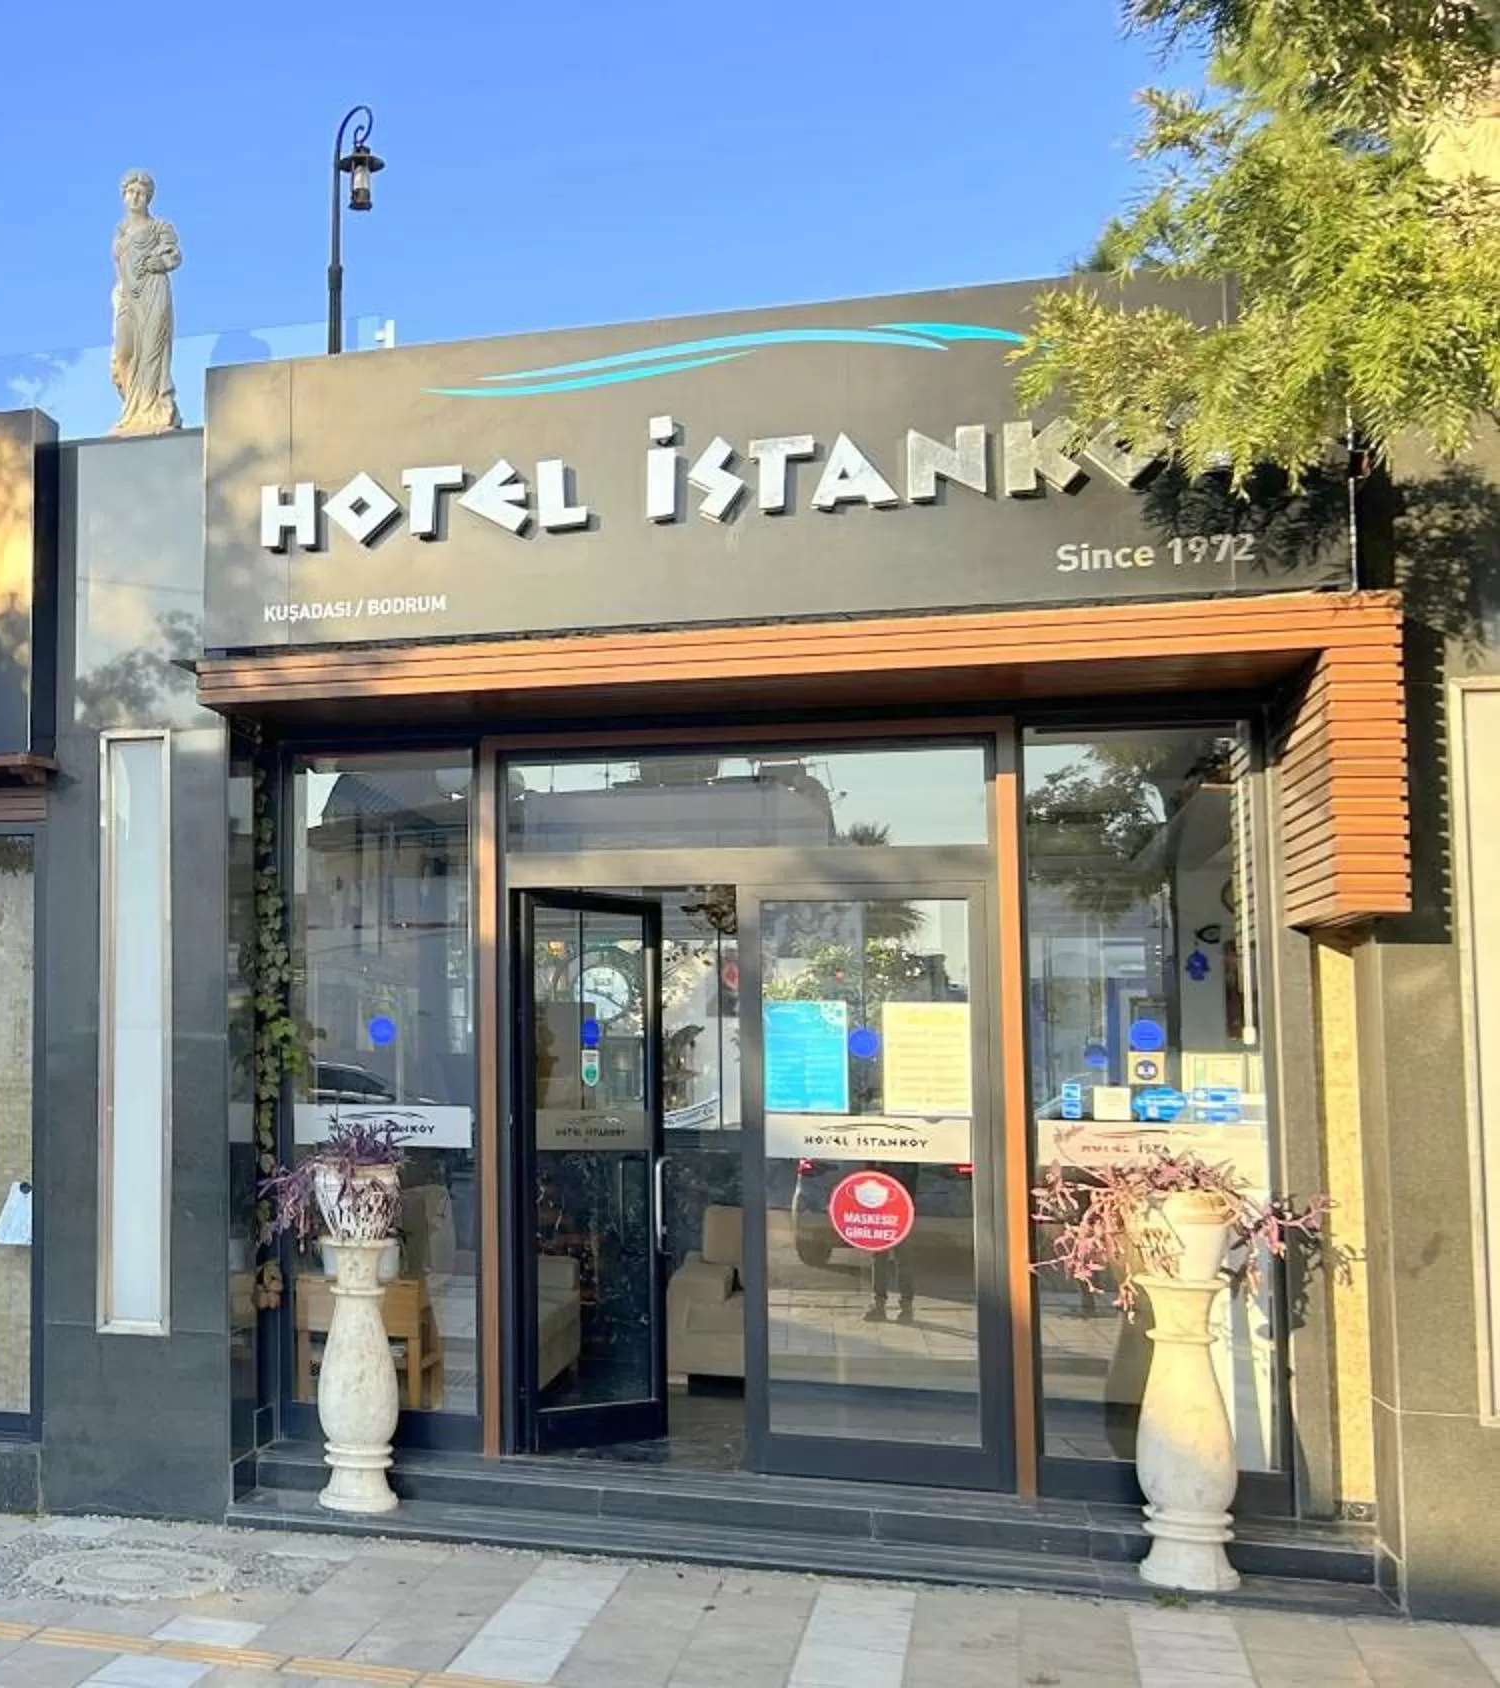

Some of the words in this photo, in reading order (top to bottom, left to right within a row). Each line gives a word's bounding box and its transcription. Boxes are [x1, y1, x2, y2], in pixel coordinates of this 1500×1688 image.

[259, 458, 589, 547] HOTEL
[1055, 541, 1155, 572] Since
[1167, 533, 1258, 566] 1972
[263, 601, 352, 624] KUŞADASI
[354, 598, 364, 618] /
[367, 595, 447, 616] BODRUM
